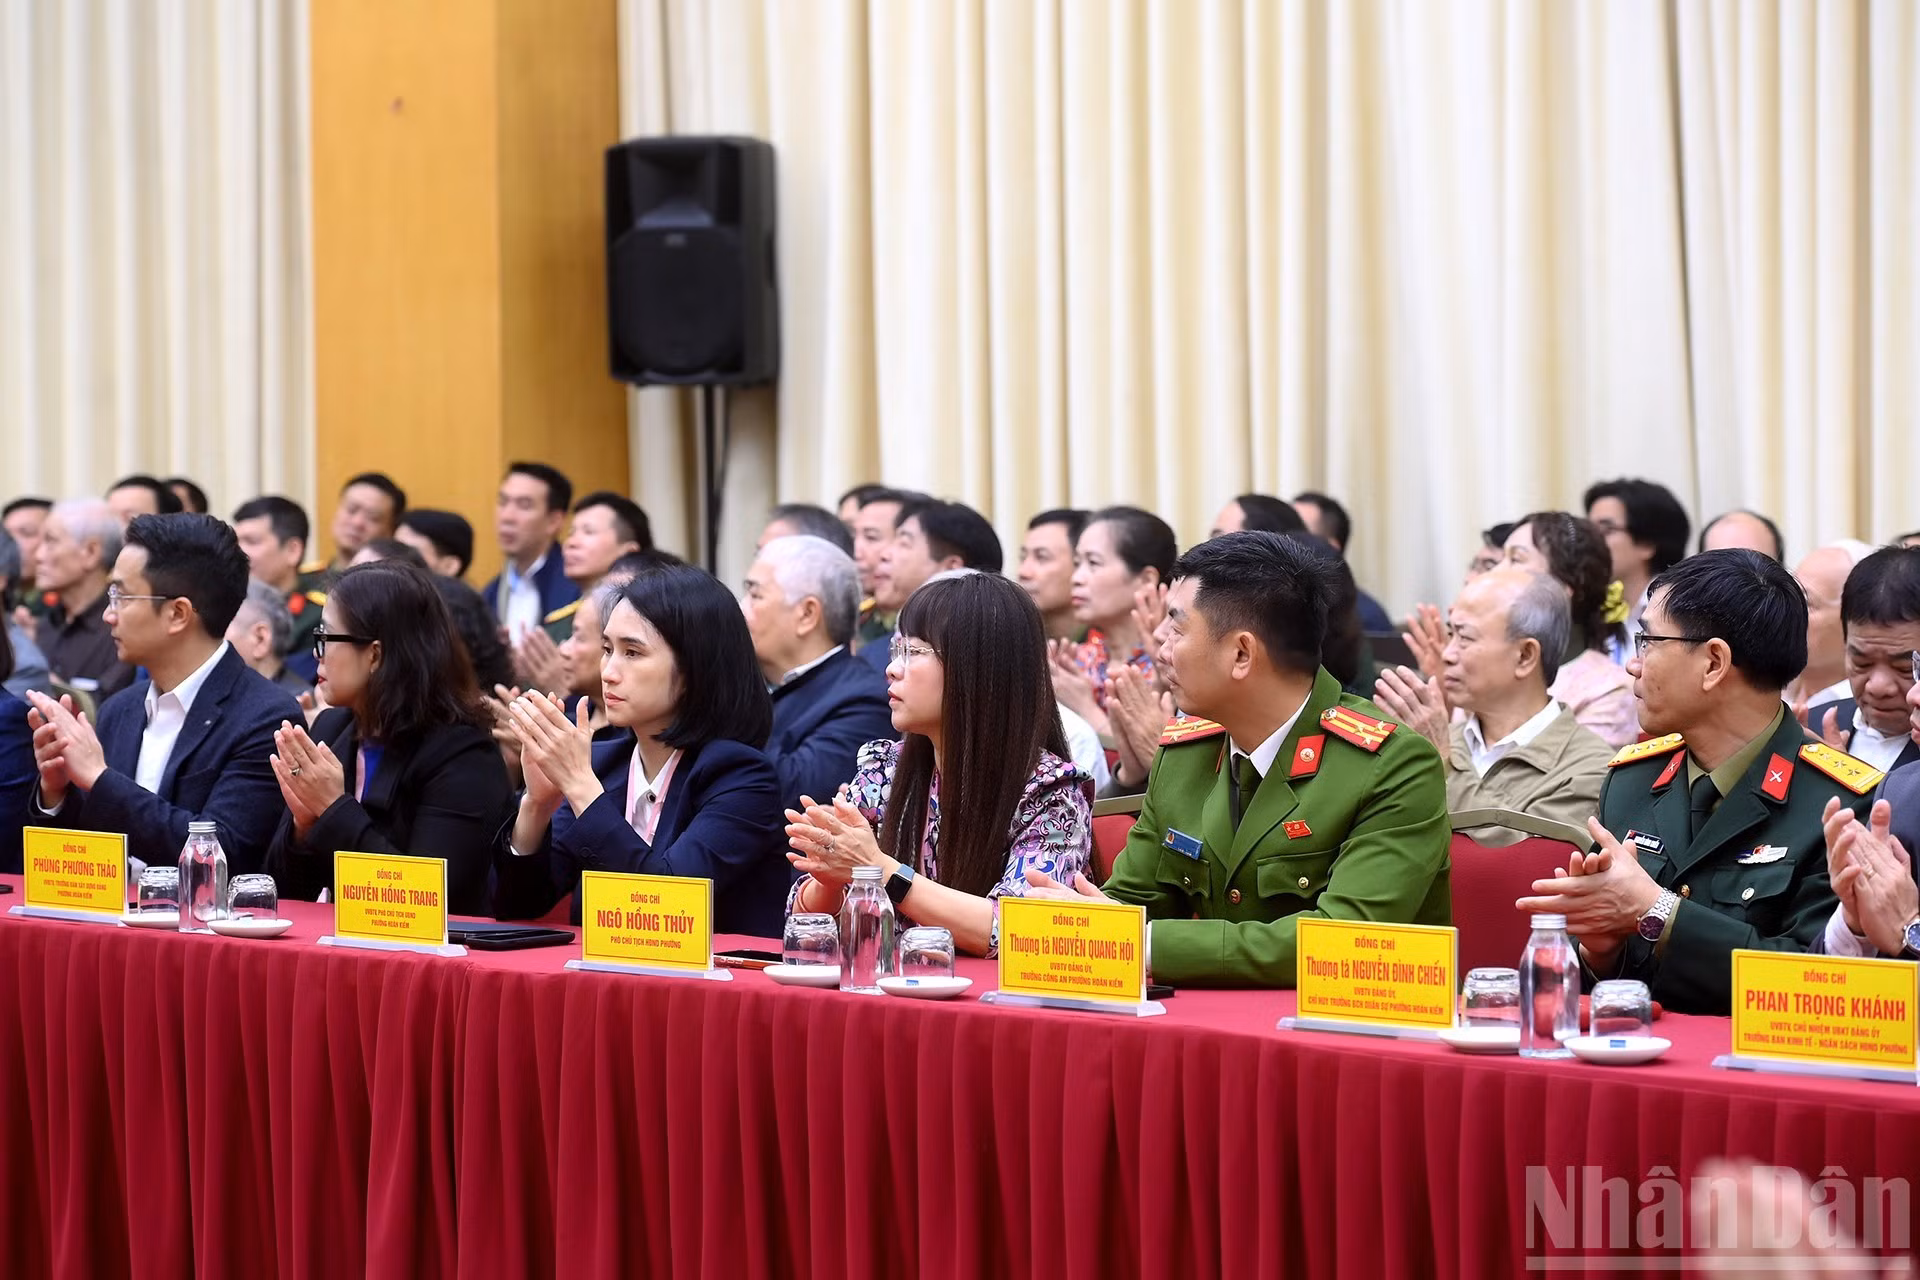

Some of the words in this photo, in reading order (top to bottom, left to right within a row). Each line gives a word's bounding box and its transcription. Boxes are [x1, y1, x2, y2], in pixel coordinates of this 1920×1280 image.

[34, 856, 60, 873] PHÙNG
[63, 860, 94, 876] PHƯƠNG
[97, 859, 117, 878] THẢO
[377, 868, 392, 880] ĐỒNG
[393, 870, 403, 881] CHÍ
[343, 881, 378, 902] NGUYỄN
[381, 883, 406, 904] HỒNG
[409, 890, 438, 907] TRANG
[631, 891, 648, 904] ĐỒNG
[649, 893, 660, 904] CHÍ
[597, 908, 622, 929] NGÔ
[626, 906, 660, 932] HỒNG
[663, 910, 694, 934] THỦY
[1053, 913, 1074, 926] ĐỒNG
[1076, 916, 1089, 928] CHÍ
[1010, 933, 1039, 957] Thượng
[1042, 936, 1049, 955] tá
[1052, 932, 1086, 957] NGUYỄN
[1088, 940, 1117, 960] QUANG
[1120, 938, 1134, 966] HỘI
[1355, 935, 1378, 949] ĐỒNG
[1381, 938, 1395, 950] CHÍ
[1059, 976, 1068, 984] AN
[1306, 956, 1338, 981] Thượng
[1341, 959, 1350, 978] tá
[1353, 955, 1389, 982] NGUYỄN
[1393, 959, 1414, 984] ĐÌNH
[1418, 960, 1446, 986] CHIẾN
[1804, 969, 1828, 983] ĐỒNG
[1831, 971, 1846, 985] CHÍ
[1746, 990, 1789, 1012] PHAN
[1794, 994, 1845, 1020] TRỌNG
[1851, 994, 1906, 1021] KHÁNH
